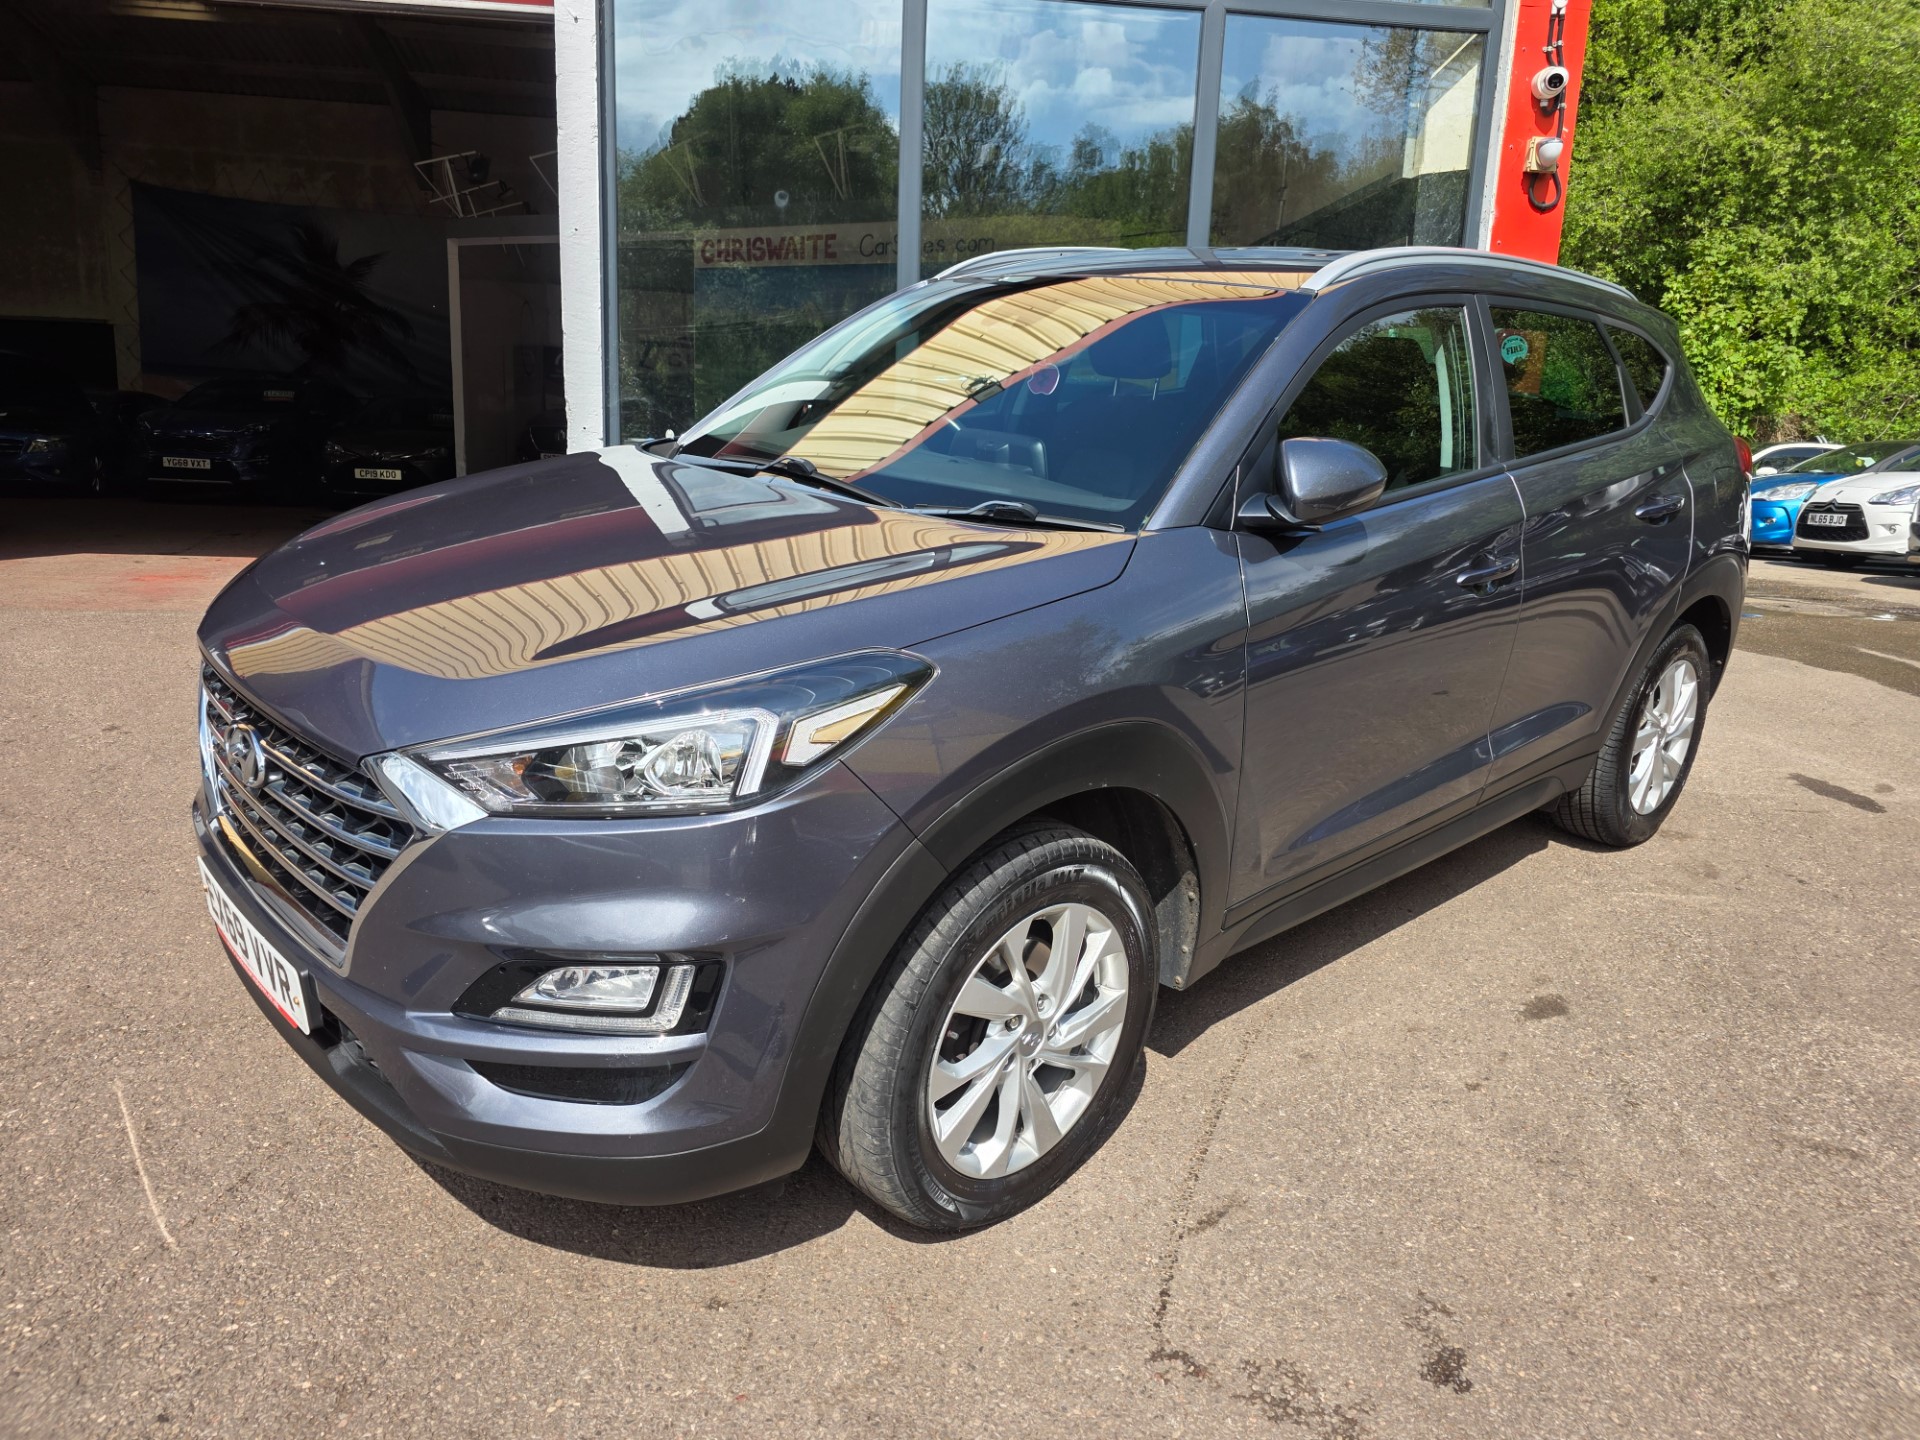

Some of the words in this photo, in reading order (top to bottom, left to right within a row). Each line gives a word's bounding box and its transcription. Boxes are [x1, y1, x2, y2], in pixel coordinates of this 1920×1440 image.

[167, 458, 188, 467] YG68
[190, 459, 206, 468] VXT
[359, 469, 378, 478] CP19
[248, 928, 295, 1012] VVR
